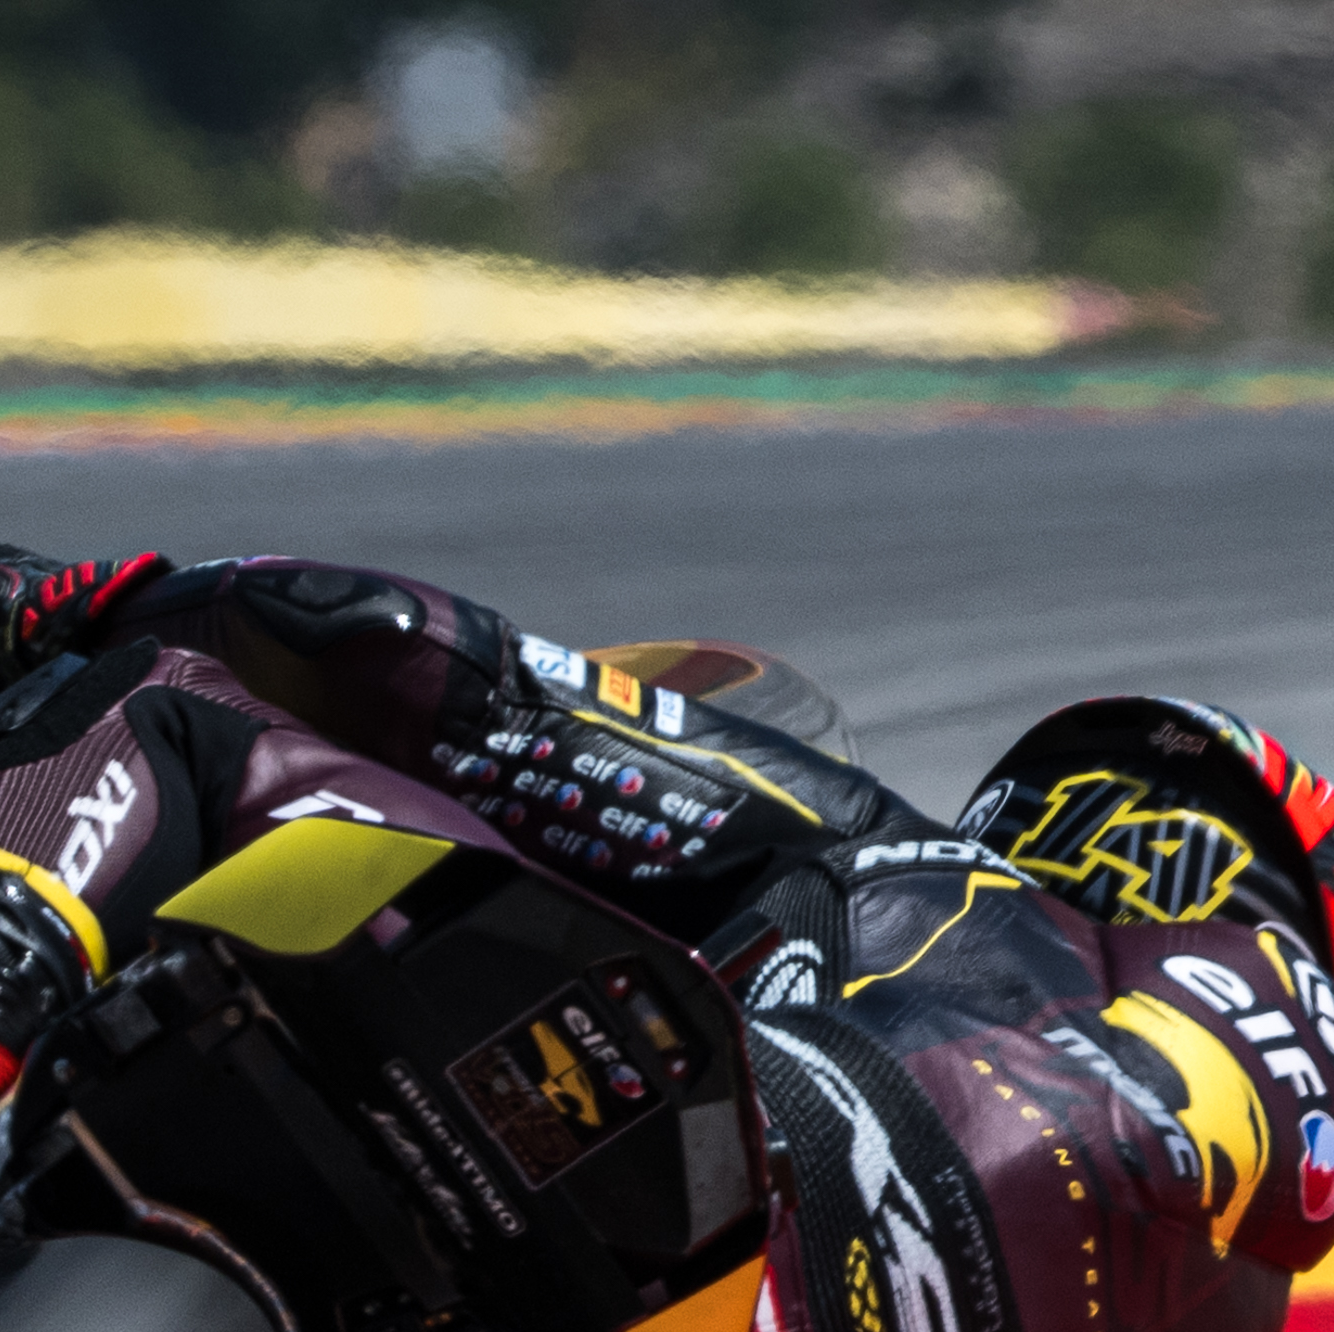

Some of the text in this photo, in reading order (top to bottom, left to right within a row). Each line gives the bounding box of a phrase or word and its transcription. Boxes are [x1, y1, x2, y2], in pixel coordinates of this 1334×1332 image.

[512, 769, 560, 799] elf
[571, 752, 620, 783] elf
[599, 806, 649, 840] elf
[659, 791, 708, 826] elf
[542, 824, 589, 857] elf
[1005, 768, 1254, 923] 14
[561, 1004, 624, 1064] elf
[1161, 954, 1328, 1099] elf
